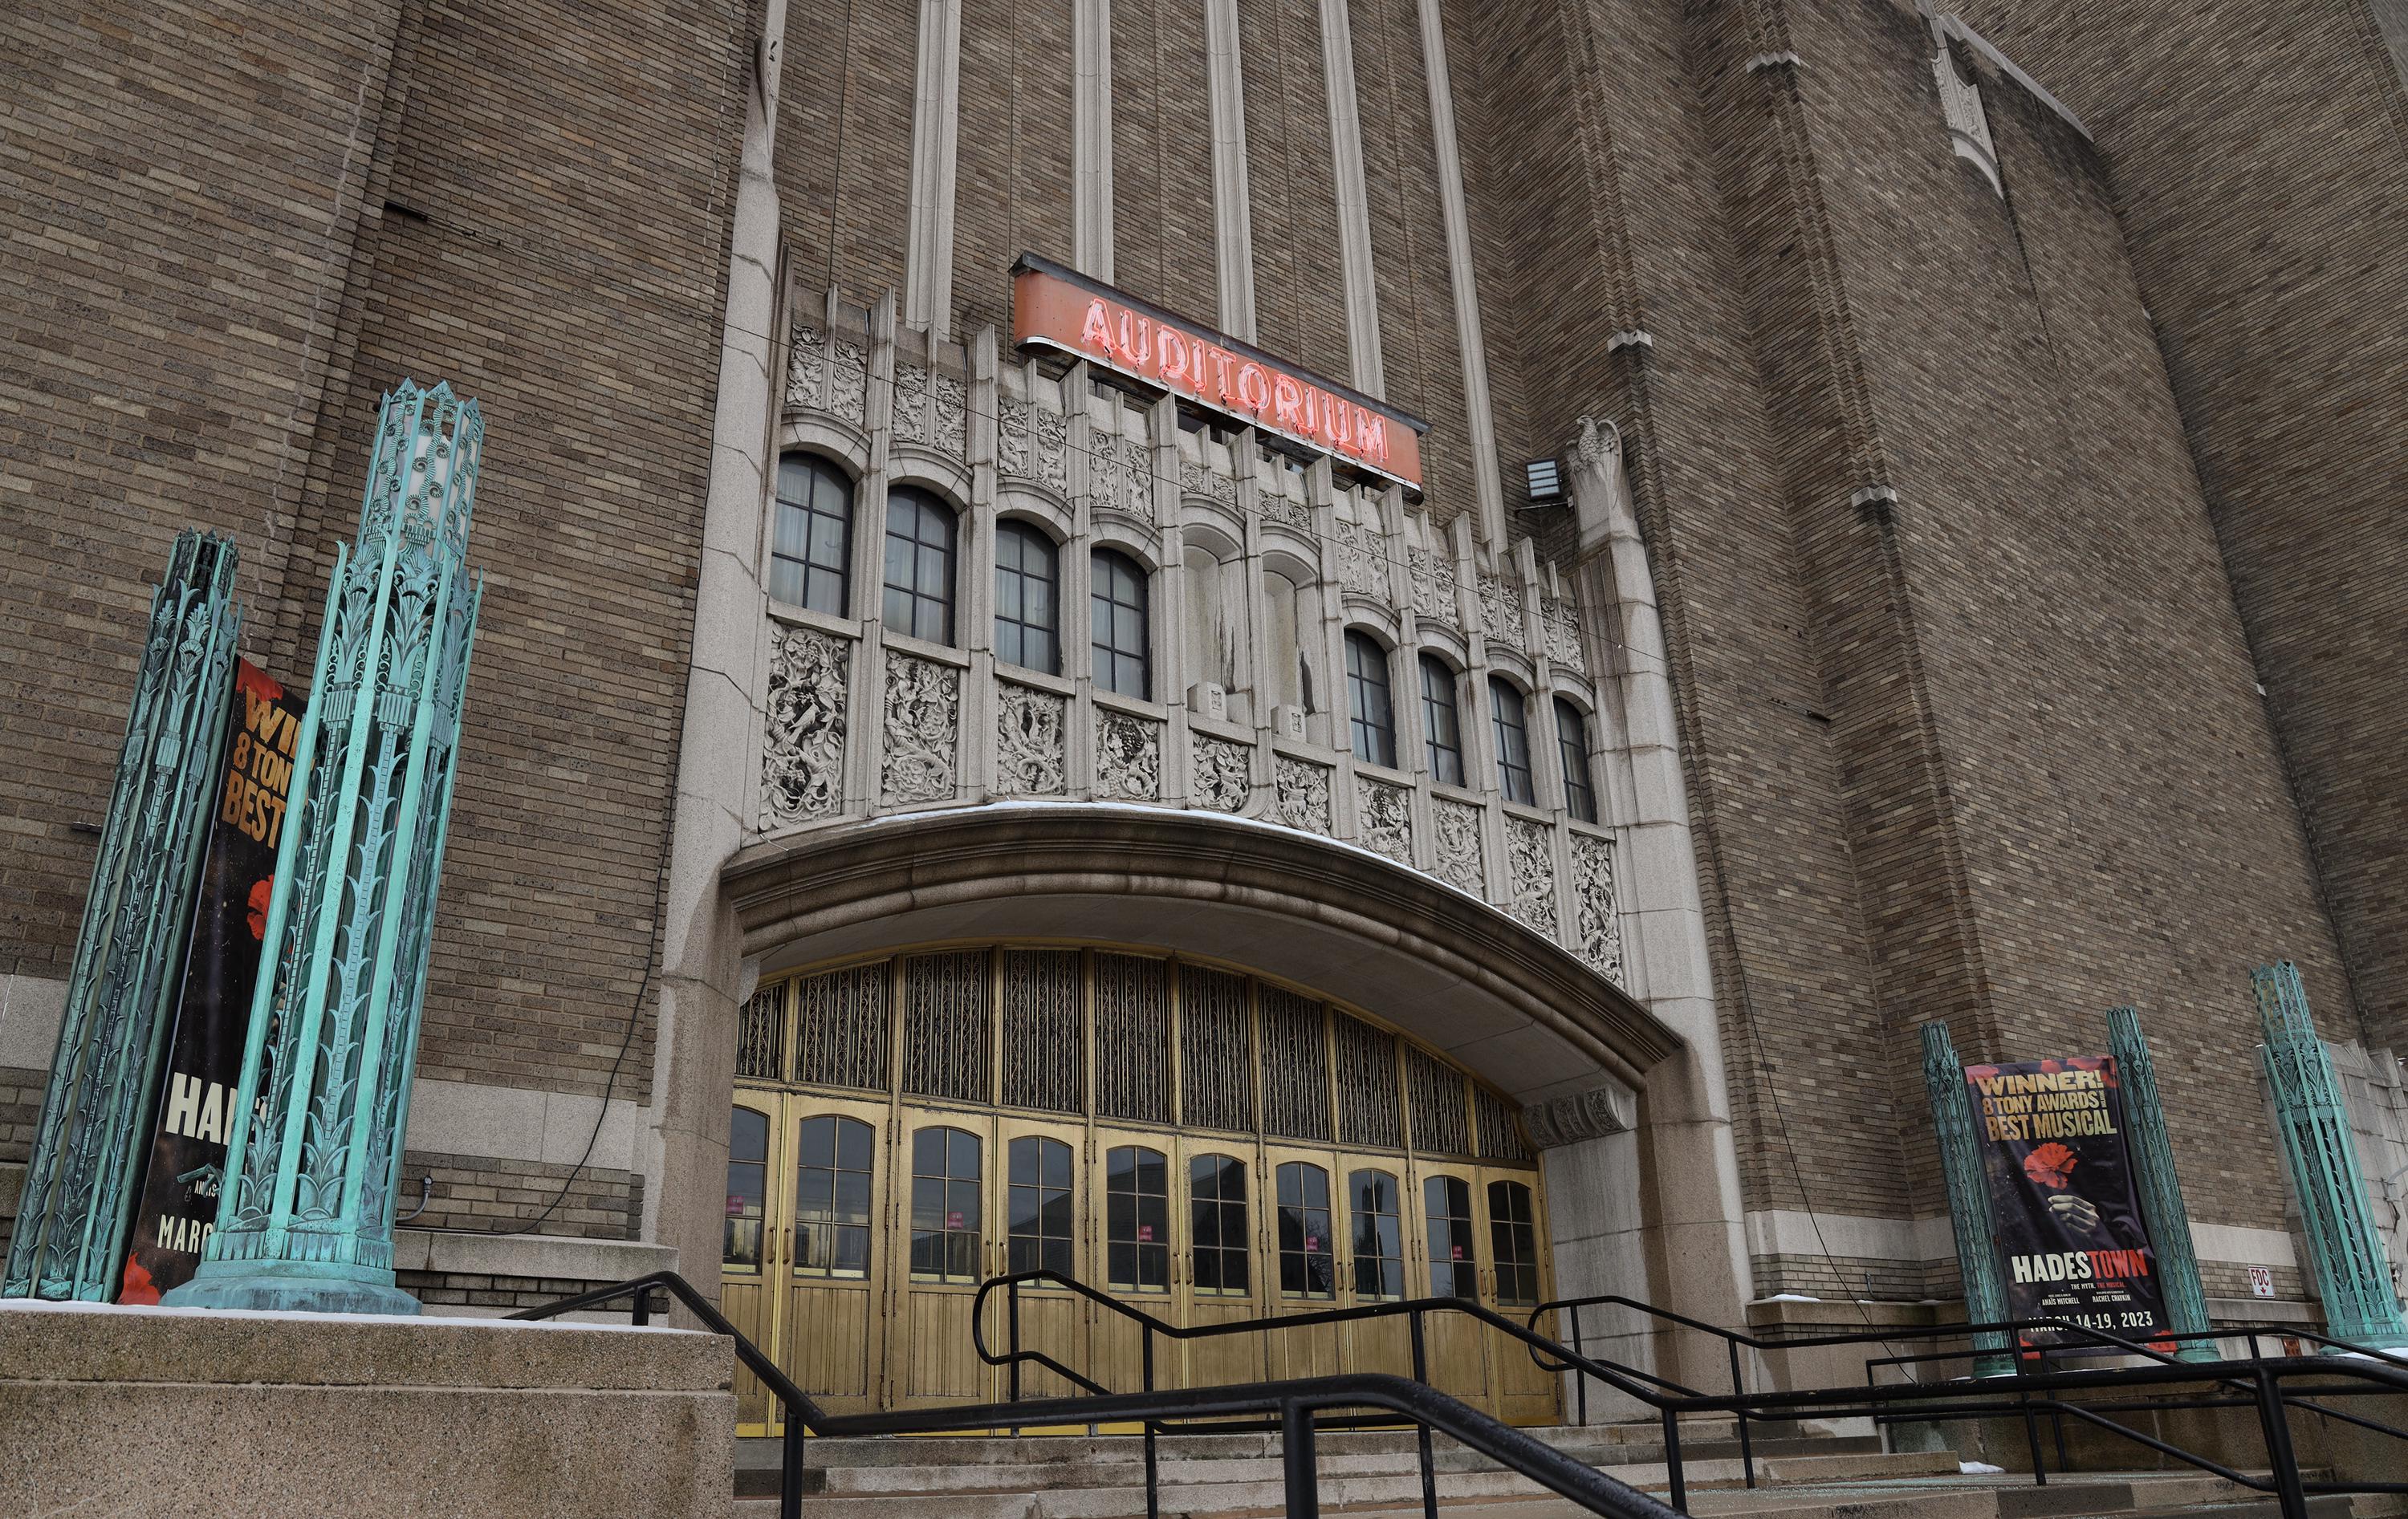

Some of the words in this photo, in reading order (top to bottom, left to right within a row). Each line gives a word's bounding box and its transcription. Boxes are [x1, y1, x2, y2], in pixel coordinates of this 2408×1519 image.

[1081, 297, 1389, 462] AUDITORIUM
[234, 731, 251, 770] 8
[251, 739, 294, 797] TON
[222, 768, 287, 849] BEST
[1976, 1070, 2104, 1095] WINNER!
[1982, 1097, 1993, 1115] 8
[1993, 1095, 2032, 1114] TONY
[2037, 1091, 2099, 1111] AWARDS
[1985, 1115, 2029, 1141] BEST
[2032, 1109, 2117, 1138] MUSICAL
[157, 1213, 214, 1254] MARC
[2011, 1249, 2148, 1283] HADESTOWN
[2251, 1269, 2268, 1286] FDC
[2057, 1297, 2080, 1306] MITCHELL
[2092, 1294, 2111, 1303] RACHEL
[2076, 1313, 2117, 1330] 14-19,
[2121, 1310, 2154, 1328] 2023
